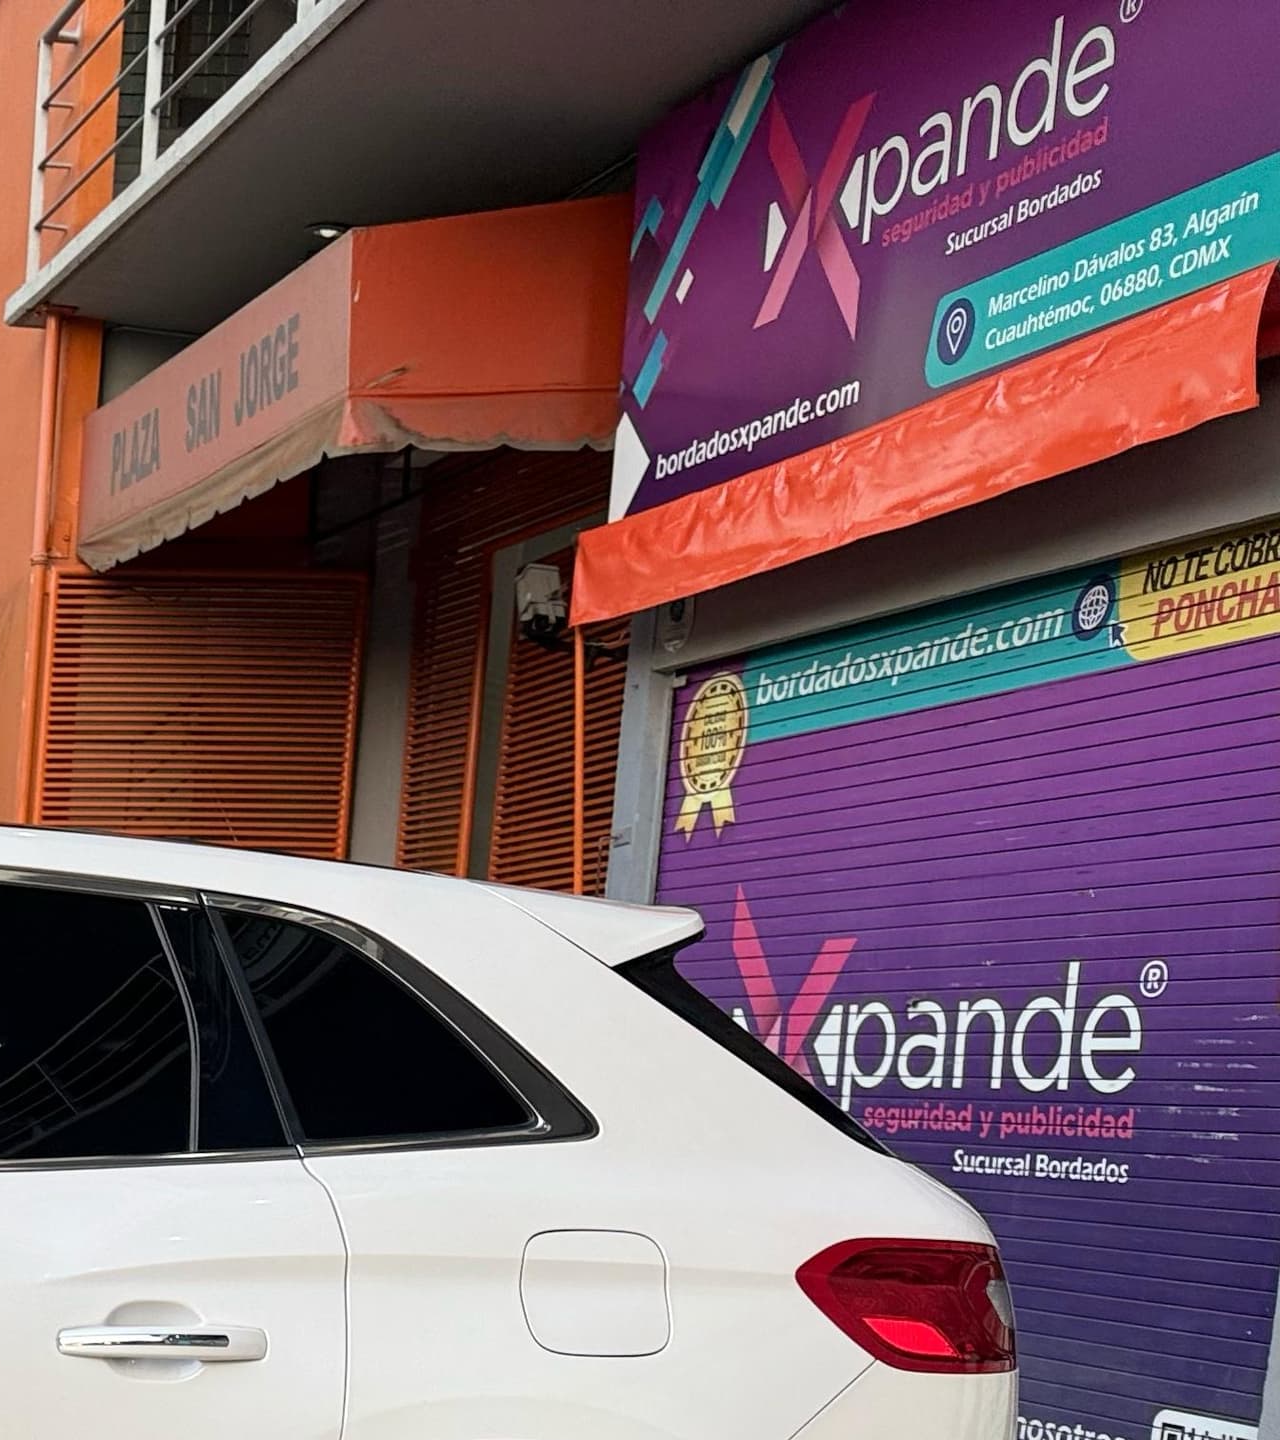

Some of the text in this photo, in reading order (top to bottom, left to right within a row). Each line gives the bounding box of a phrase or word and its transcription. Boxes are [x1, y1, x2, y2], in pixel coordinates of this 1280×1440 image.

[882, 116, 1109, 247] seguridad y publicidad
[945, 168, 1103, 255] Sucursal Bordados
[985, 235, 1232, 350] Cuauhtémoc, 06880, CDMX
[988, 191, 1259, 317] Marcelino Dávalos 83, Algarín
[110, 312, 300, 495] PLAZA SAN JORGE
[655, 380, 860, 480] bordadosxpande.com
[1142, 556, 1178, 594] NO
[1184, 547, 1213, 584] TE
[756, 606, 1065, 706] bordadosxpande.com
[863, 1102, 1135, 1139] seguridad y publicidad
[952, 1149, 1129, 1183] Sucursal Bordados
